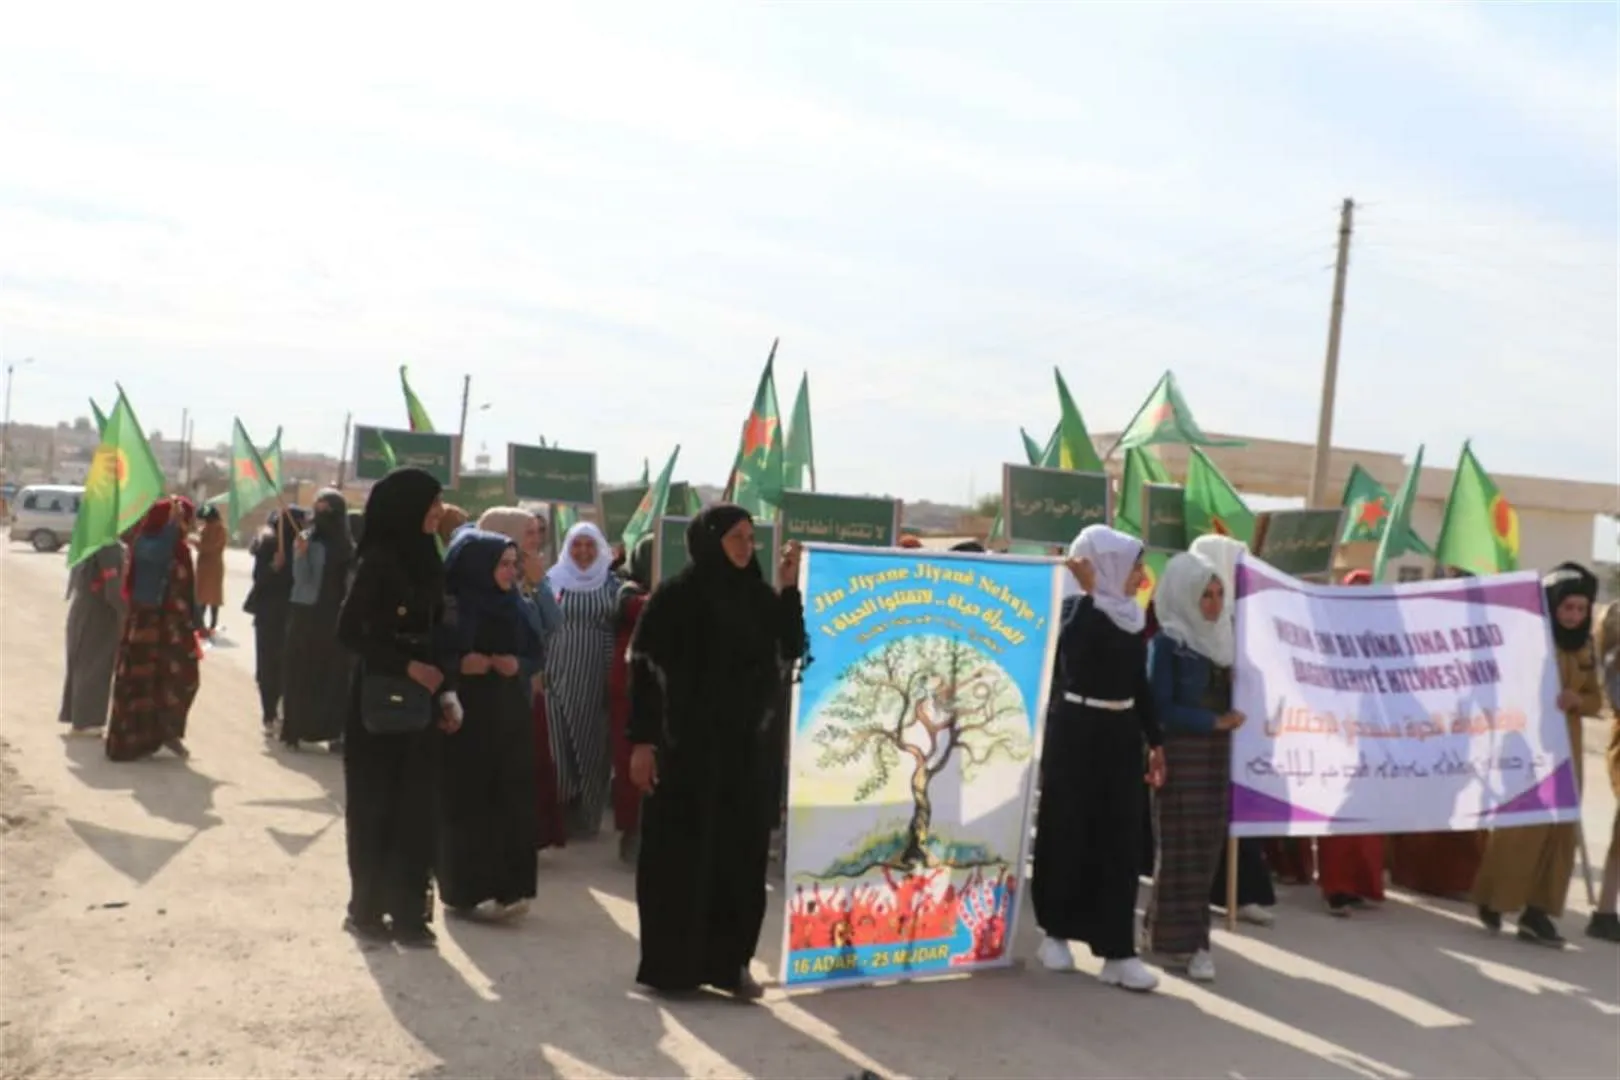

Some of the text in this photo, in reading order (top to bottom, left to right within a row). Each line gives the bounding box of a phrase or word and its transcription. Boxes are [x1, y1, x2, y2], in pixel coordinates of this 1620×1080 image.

[814, 588, 845, 614] Jin
[1449, 623, 1504, 651] AZAD
[793, 958, 810, 974] 16
[871, 951, 889, 968] 25
